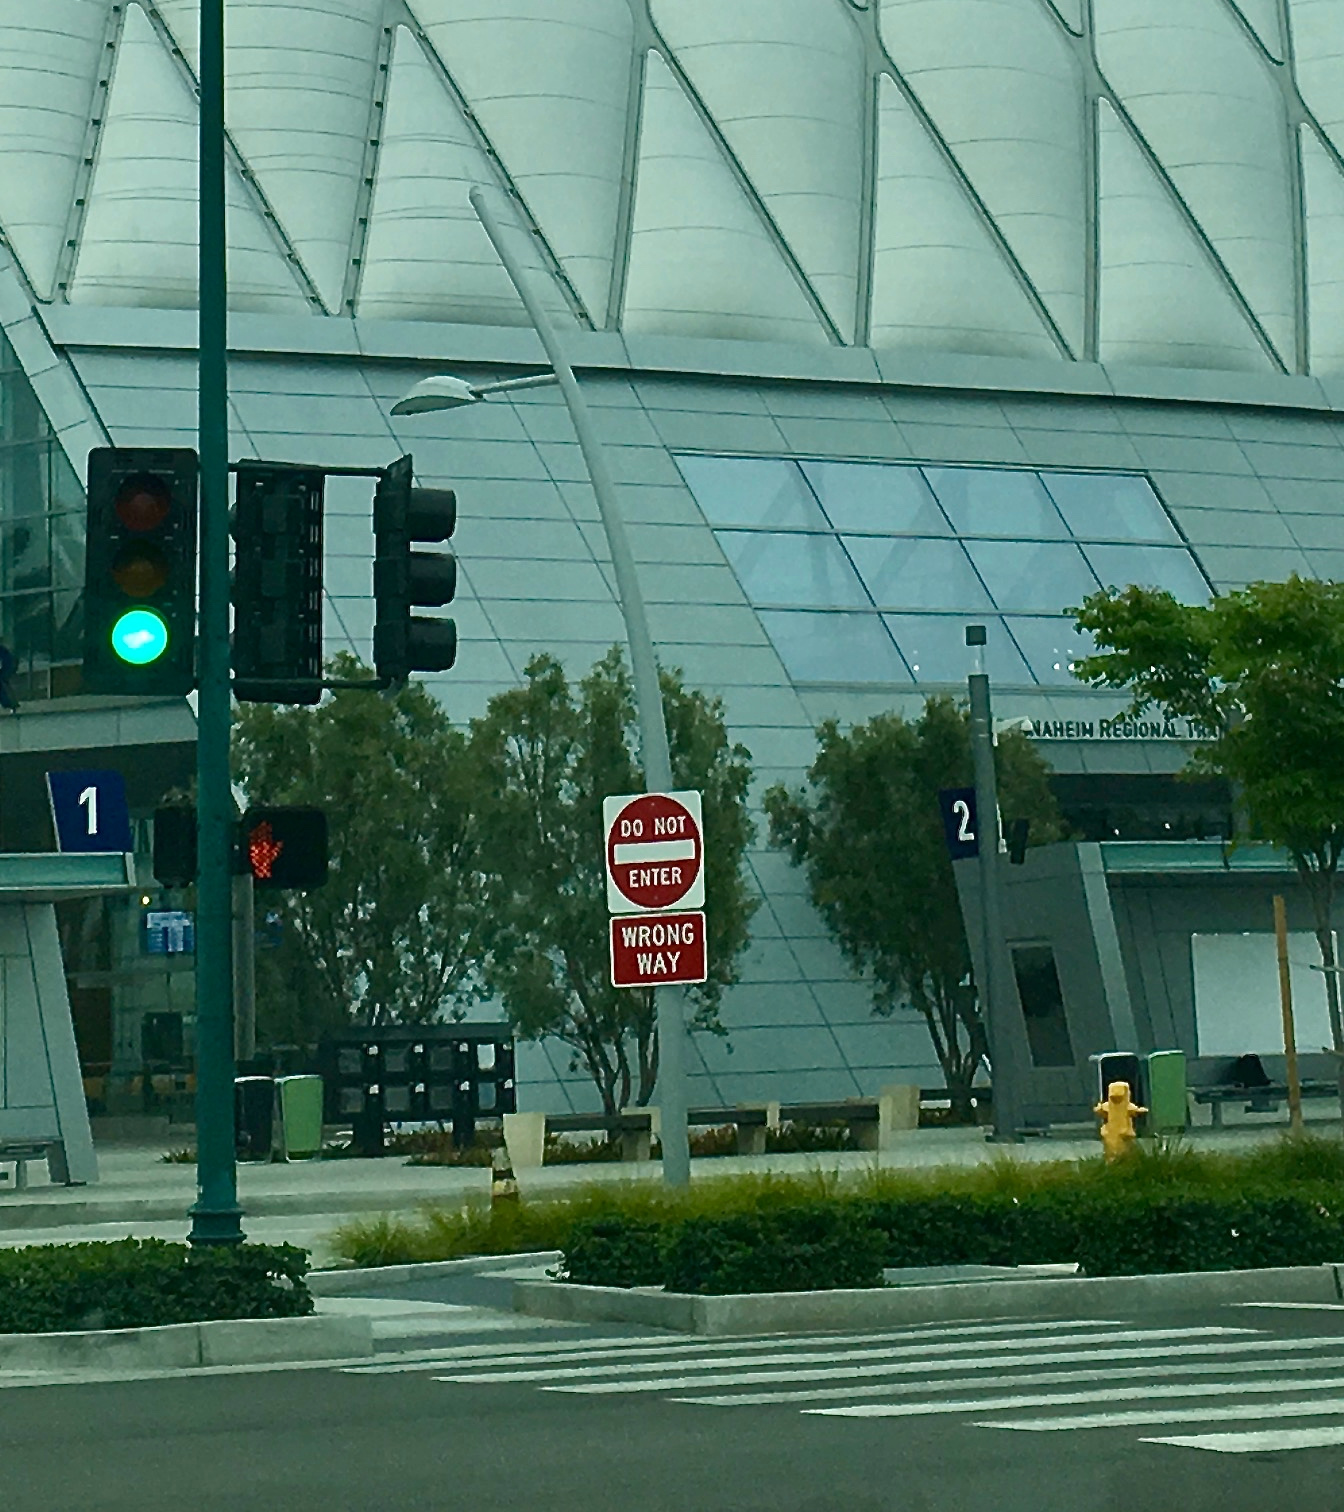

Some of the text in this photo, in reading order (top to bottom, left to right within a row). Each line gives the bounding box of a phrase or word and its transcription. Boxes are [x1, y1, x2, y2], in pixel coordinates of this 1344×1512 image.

[1025, 720, 1094, 738] NAHEIM
[1099, 719, 1181, 738] REGIONAL
[78, 786, 98, 835] 1
[953, 800, 975, 842] 2
[621, 815, 686, 837] DO NOT
[629, 866, 682, 888] ENTER
[621, 922, 695, 948] WRONG
[637, 950, 681, 976] WAY
